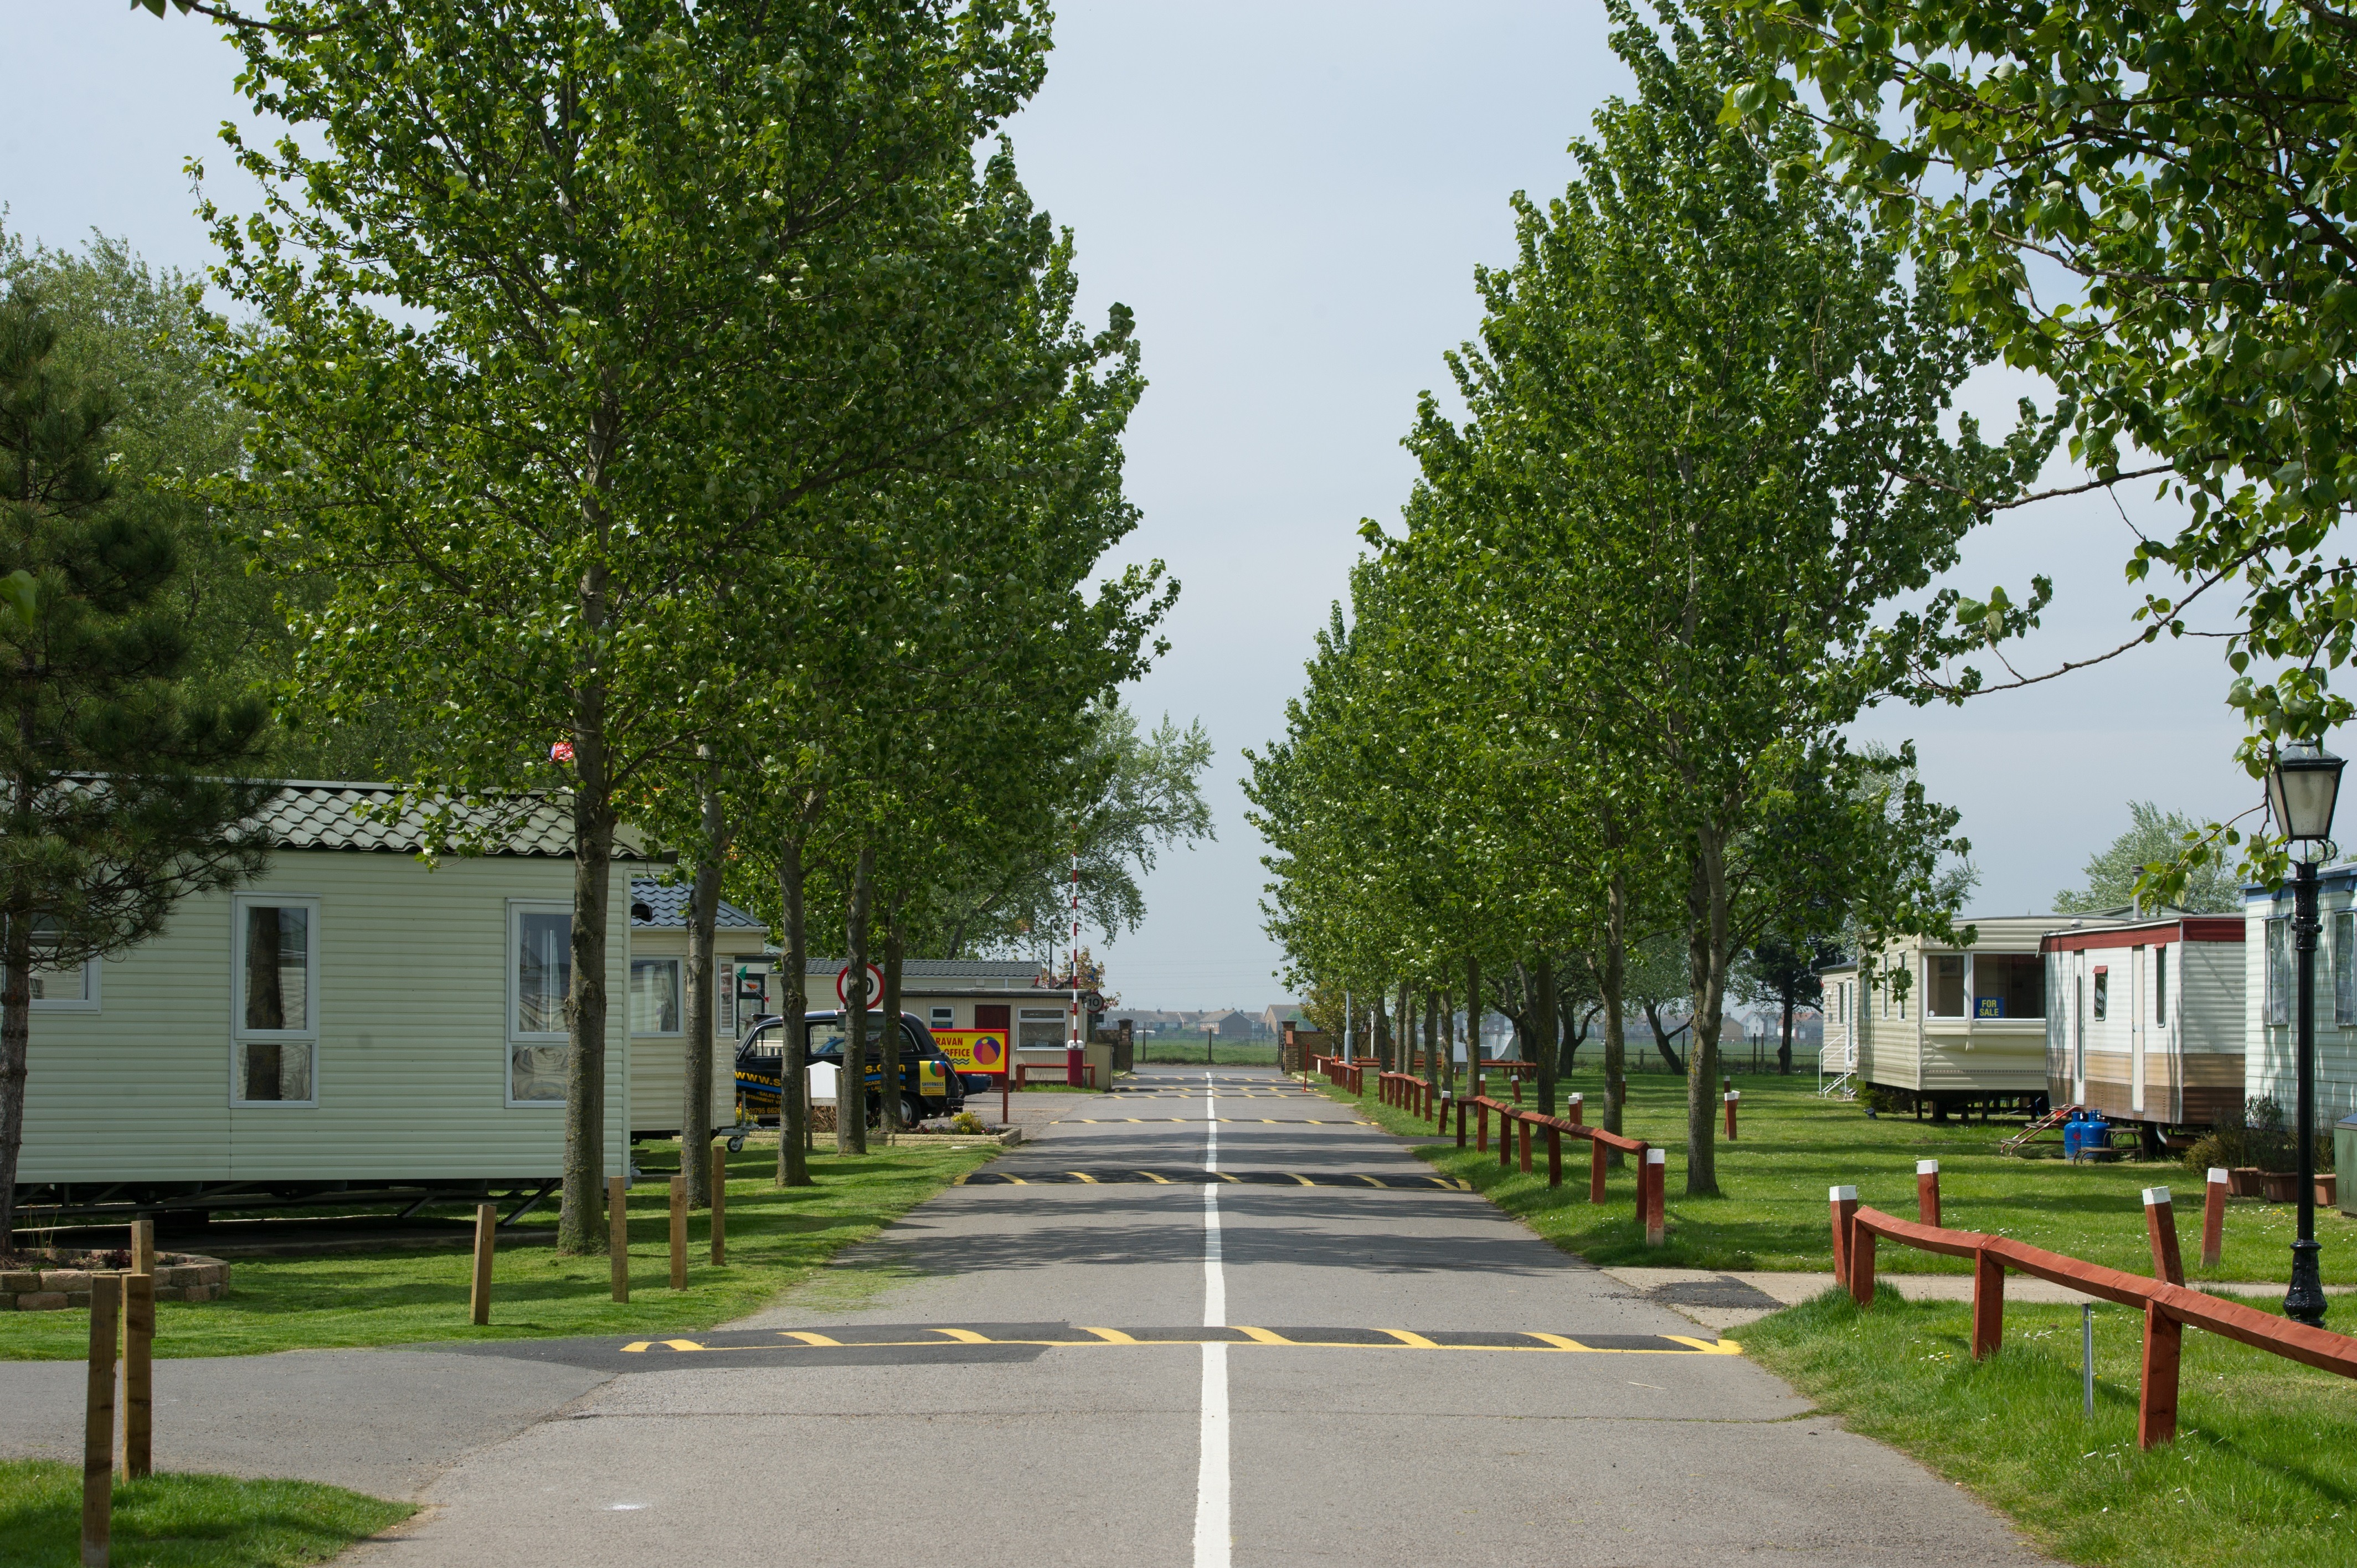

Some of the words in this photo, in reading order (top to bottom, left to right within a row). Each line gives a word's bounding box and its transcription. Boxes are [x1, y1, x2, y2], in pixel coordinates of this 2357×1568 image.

[1088, 998, 1099, 1007] 10
[1982, 999, 1996, 1008] FOR
[935, 1037, 963, 1046] RAVAN
[944, 1048, 970, 1056] OFFICE
[734, 1071, 781, 1086] www.s
